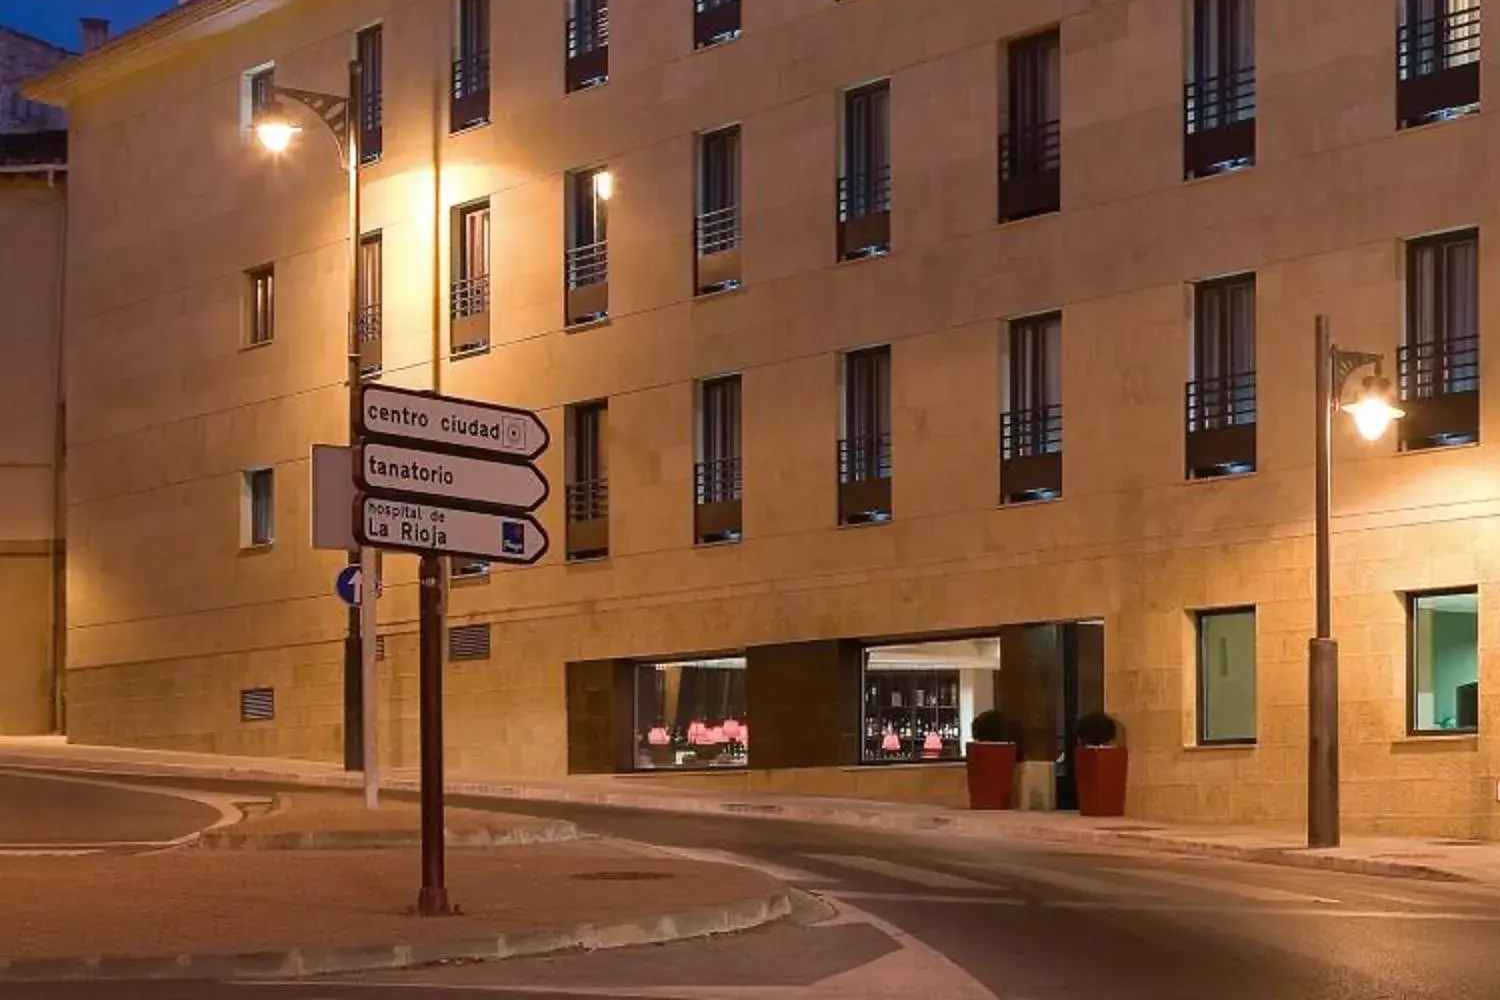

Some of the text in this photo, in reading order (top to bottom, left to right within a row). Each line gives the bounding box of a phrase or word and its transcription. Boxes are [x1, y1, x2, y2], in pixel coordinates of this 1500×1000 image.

[368, 403, 501, 440] centro ciudad
[368, 457, 453, 485] tanatorio
[368, 502, 445, 523] hospital de
[368, 517, 447, 546] La Rioja
